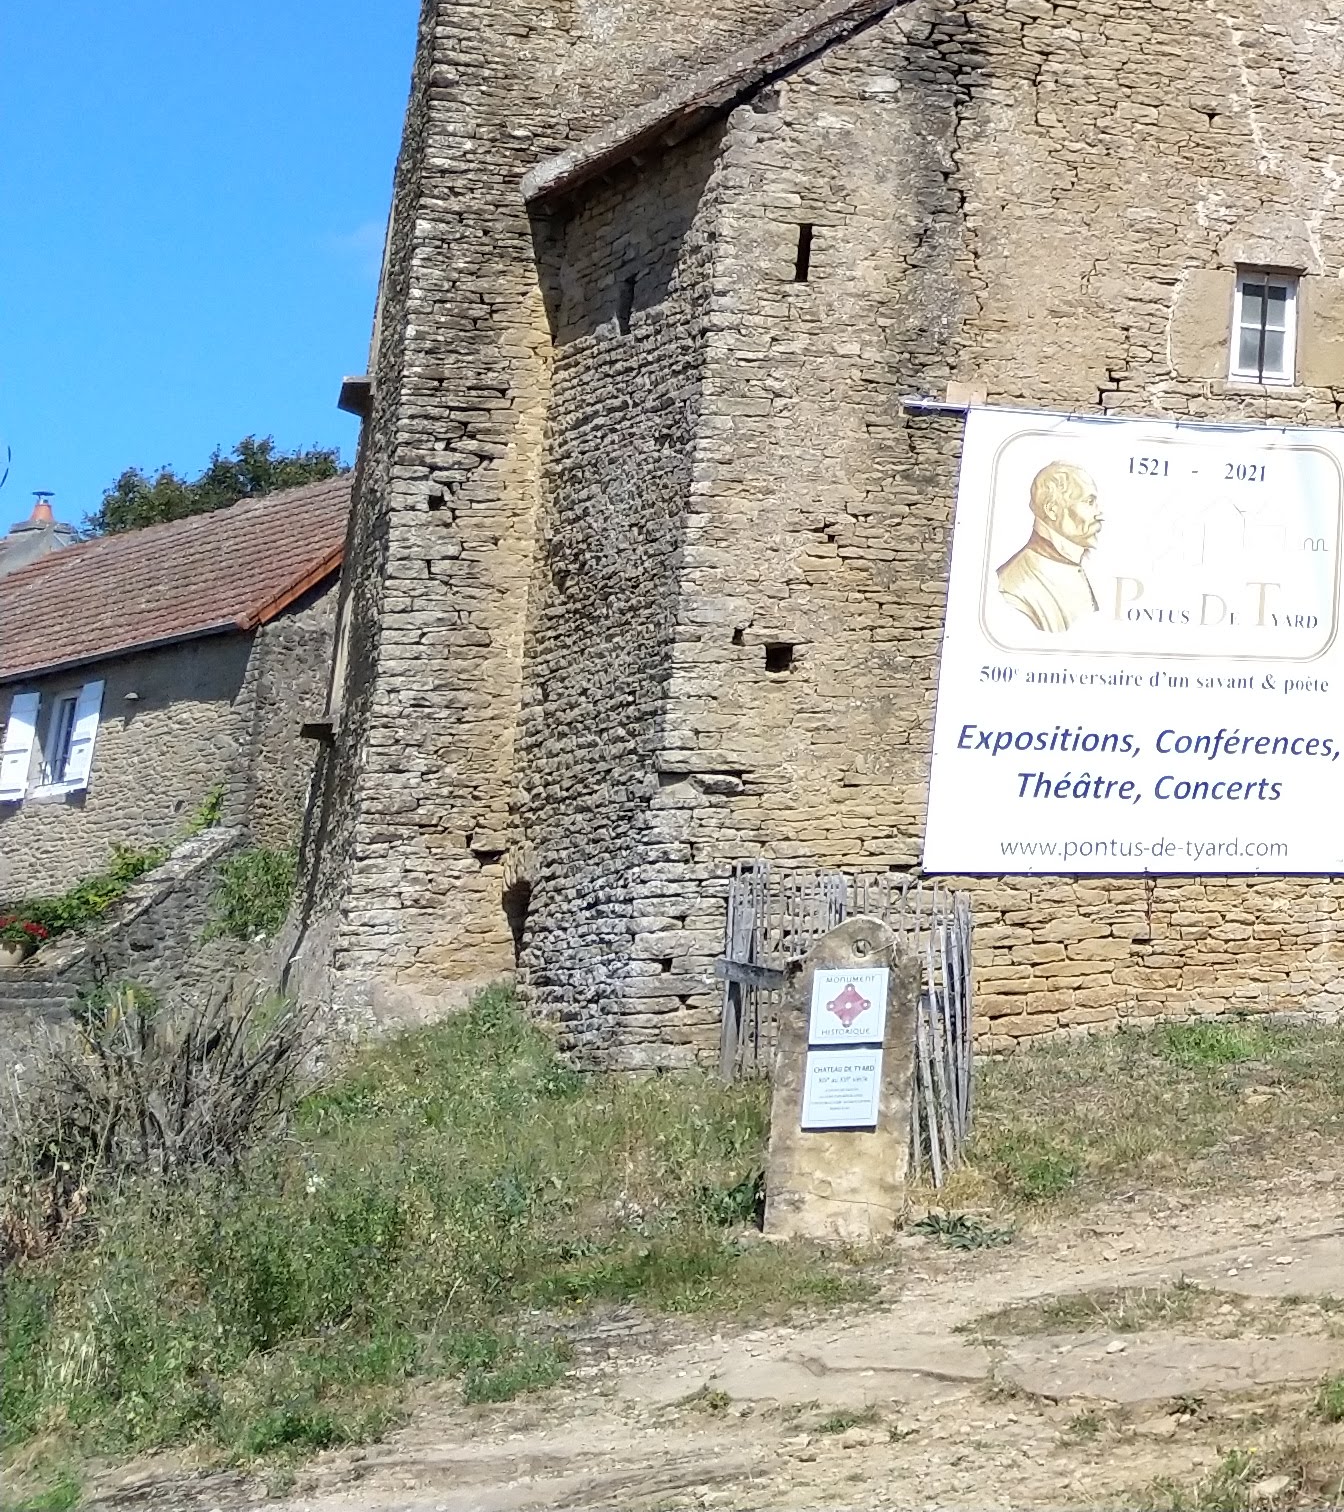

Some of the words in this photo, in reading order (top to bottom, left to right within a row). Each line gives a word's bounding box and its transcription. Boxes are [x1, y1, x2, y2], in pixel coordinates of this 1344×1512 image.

[1128, 456, 1170, 477] 1521
[1224, 463, 1267, 482] 2021
[1112, 576, 1190, 624] PONTUS
[1245, 582, 1319, 630] TYARD
[1025, 668, 1143, 688] anniversaire
[1196, 674, 1255, 690] savant
[1261, 674, 1276, 691] &
[1284, 675, 1330, 694] poète
[957, 724, 1142, 759] Expositions,
[1155, 728, 1342, 762] Conférences,
[1017, 771, 1142, 805] Théâtre,
[1153, 775, 1283, 802] Concerts
[1000, 837, 1289, 861] www.pontus-de-tyard.com
[821, 1028, 871, 1036] HISTORIQUE
